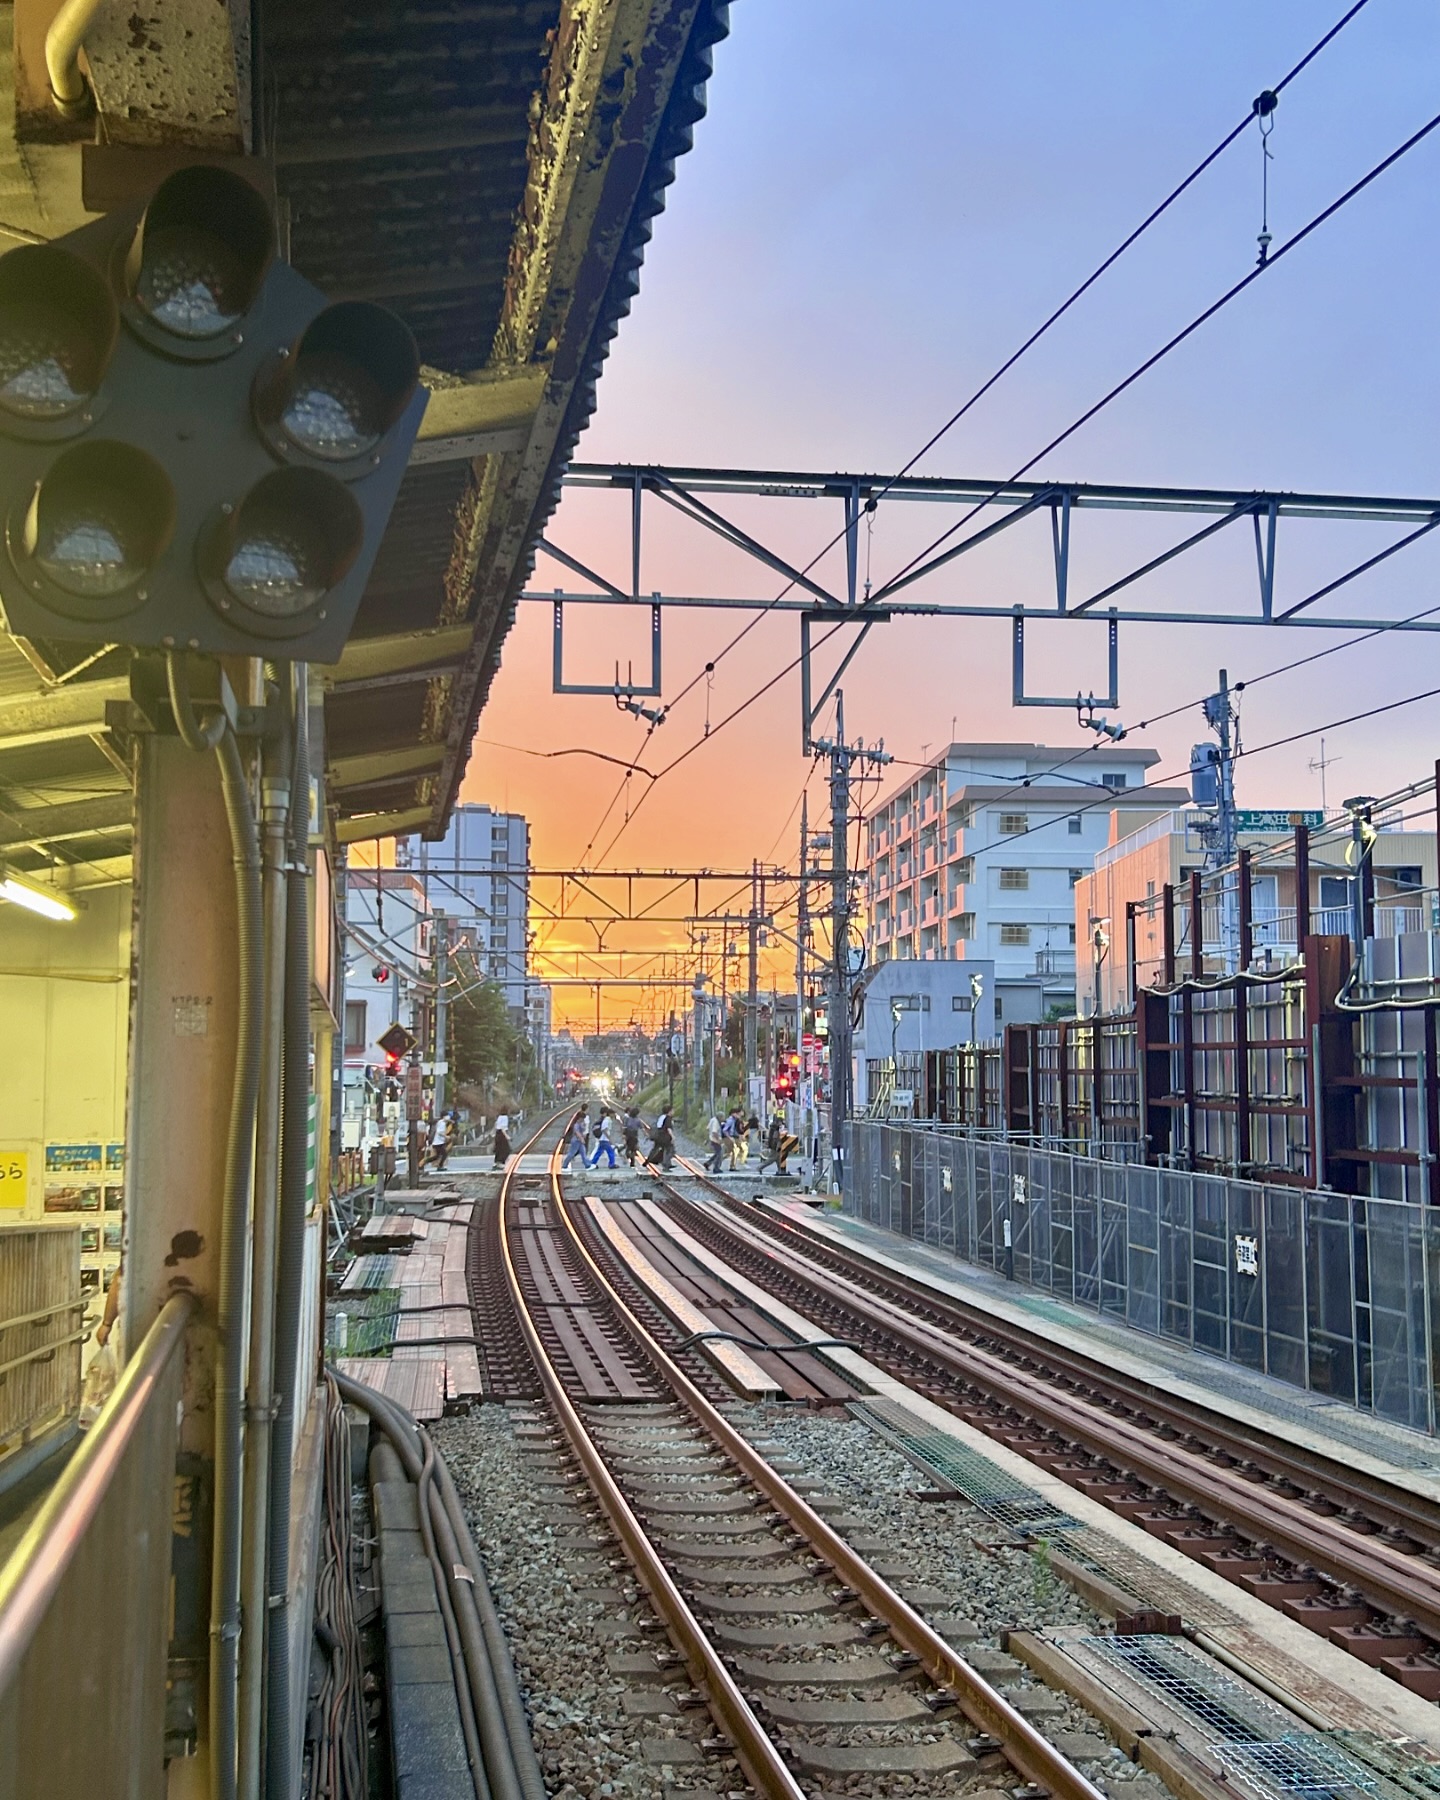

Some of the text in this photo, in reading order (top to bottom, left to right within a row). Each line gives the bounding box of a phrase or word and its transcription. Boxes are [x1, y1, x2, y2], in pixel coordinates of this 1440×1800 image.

[1246, 813, 1317, 827] 上高田眼科
